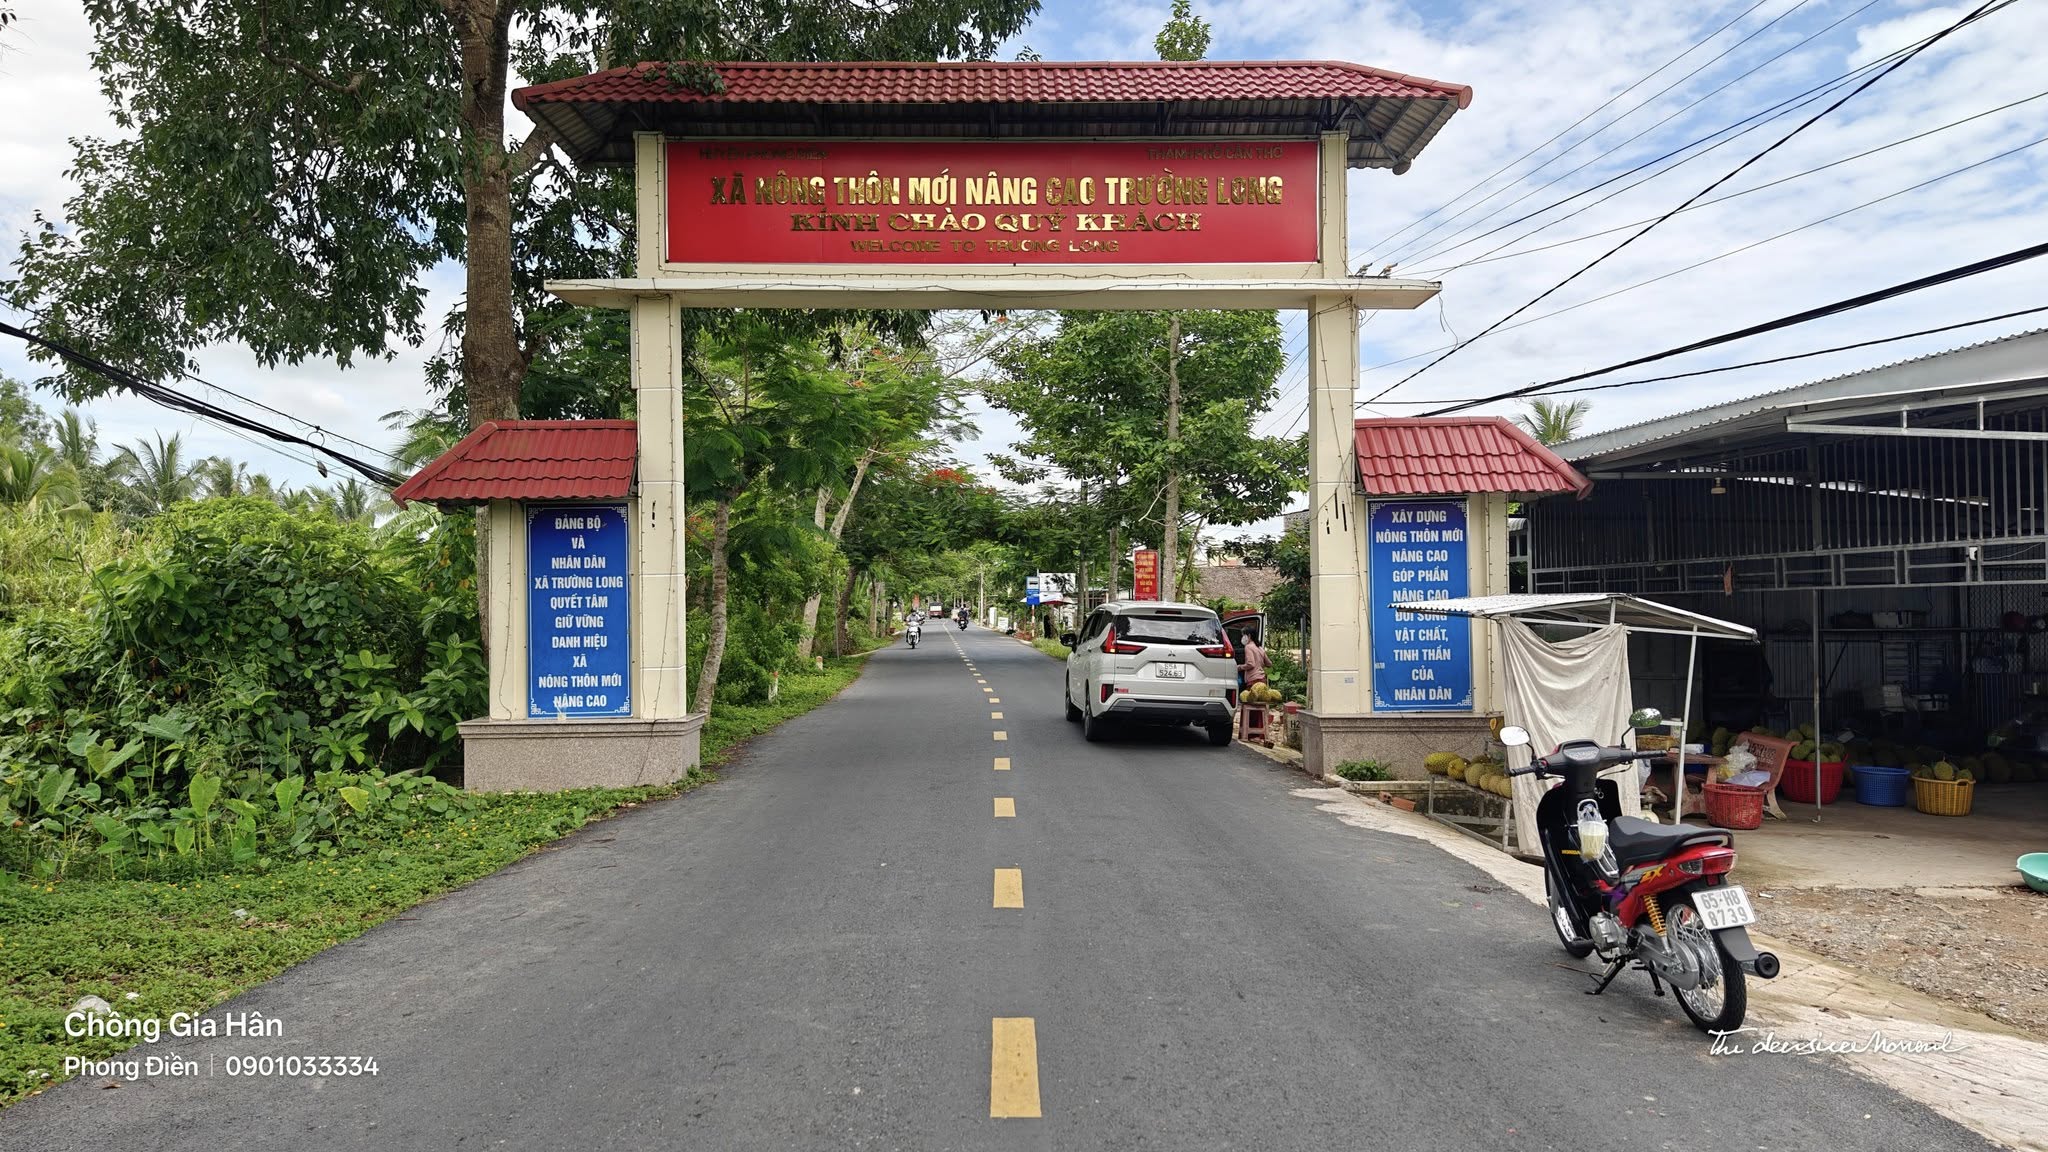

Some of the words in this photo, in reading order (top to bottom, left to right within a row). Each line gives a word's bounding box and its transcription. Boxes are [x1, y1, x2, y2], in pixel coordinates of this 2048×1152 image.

[711, 172, 746, 204] XÃ
[755, 169, 826, 204] NÔNG
[833, 170, 900, 205] THÔN
[908, 168, 957, 205] MỚI
[965, 171, 1037, 205] NÂNG
[1046, 177, 1096, 205] CAO
[1105, 167, 1208, 205] TRƯỜNG
[1217, 176, 1283, 205] LONG
[790, 207, 880, 231] KÍNH
[888, 207, 986, 232] CHÀO
[994, 207, 1067, 232] QUÝ
[1076, 207, 1202, 231] KHÁCH
[850, 239, 941, 252] WELCOME
[951, 239, 976, 252] TO
[1069, 239, 1120, 252] LONG
[555, 514, 584, 530] ĐẢNG
[586, 515, 601, 532] BỘ
[1391, 509, 1413, 523] XÂY
[1416, 510, 1447, 525] DỰNG
[571, 535, 586, 549] VÀ
[1375, 528, 1407, 543] NÔNG
[1410, 528, 1439, 543] THÔN
[1442, 528, 1464, 542] MỚI
[551, 555, 581, 569] NHÂN
[583, 555, 606, 569] DÂN
[1392, 548, 1423, 562] NÂNG
[1426, 549, 1448, 562] CAO
[535, 575, 549, 589] XÃ
[551, 574, 593, 589] TRƯỜNG
[596, 576, 623, 589] LONG
[1392, 568, 1415, 582] GÓP
[550, 593, 583, 610] QUYẾT
[585, 594, 608, 608] TÂM
[1392, 588, 1424, 602] NÂNG
[1427, 589, 1449, 601] CAO
[555, 614, 574, 629] GIỮ
[575, 614, 604, 628] VỮNG
[552, 636, 581, 649] DANH
[583, 633, 608, 650] HIỆU
[1395, 627, 1415, 644] VẬT
[1418, 625, 1449, 642] CHẤT,
[573, 654, 587, 668] XÃ
[1393, 649, 1419, 661] TINH
[538, 674, 568, 688] NÔNG
[571, 673, 598, 687] THÔN
[601, 672, 622, 687] MỚI
[1411, 665, 1435, 681] CỦA
[553, 693, 583, 708] NÂNG
[586, 695, 607, 707] CAO
[1394, 686, 1426, 701] NHÂN
[1429, 686, 1453, 701] DÂN
[1700, 889, 1741, 910] 65-H8
[1707, 906, 1749, 927] 8739
